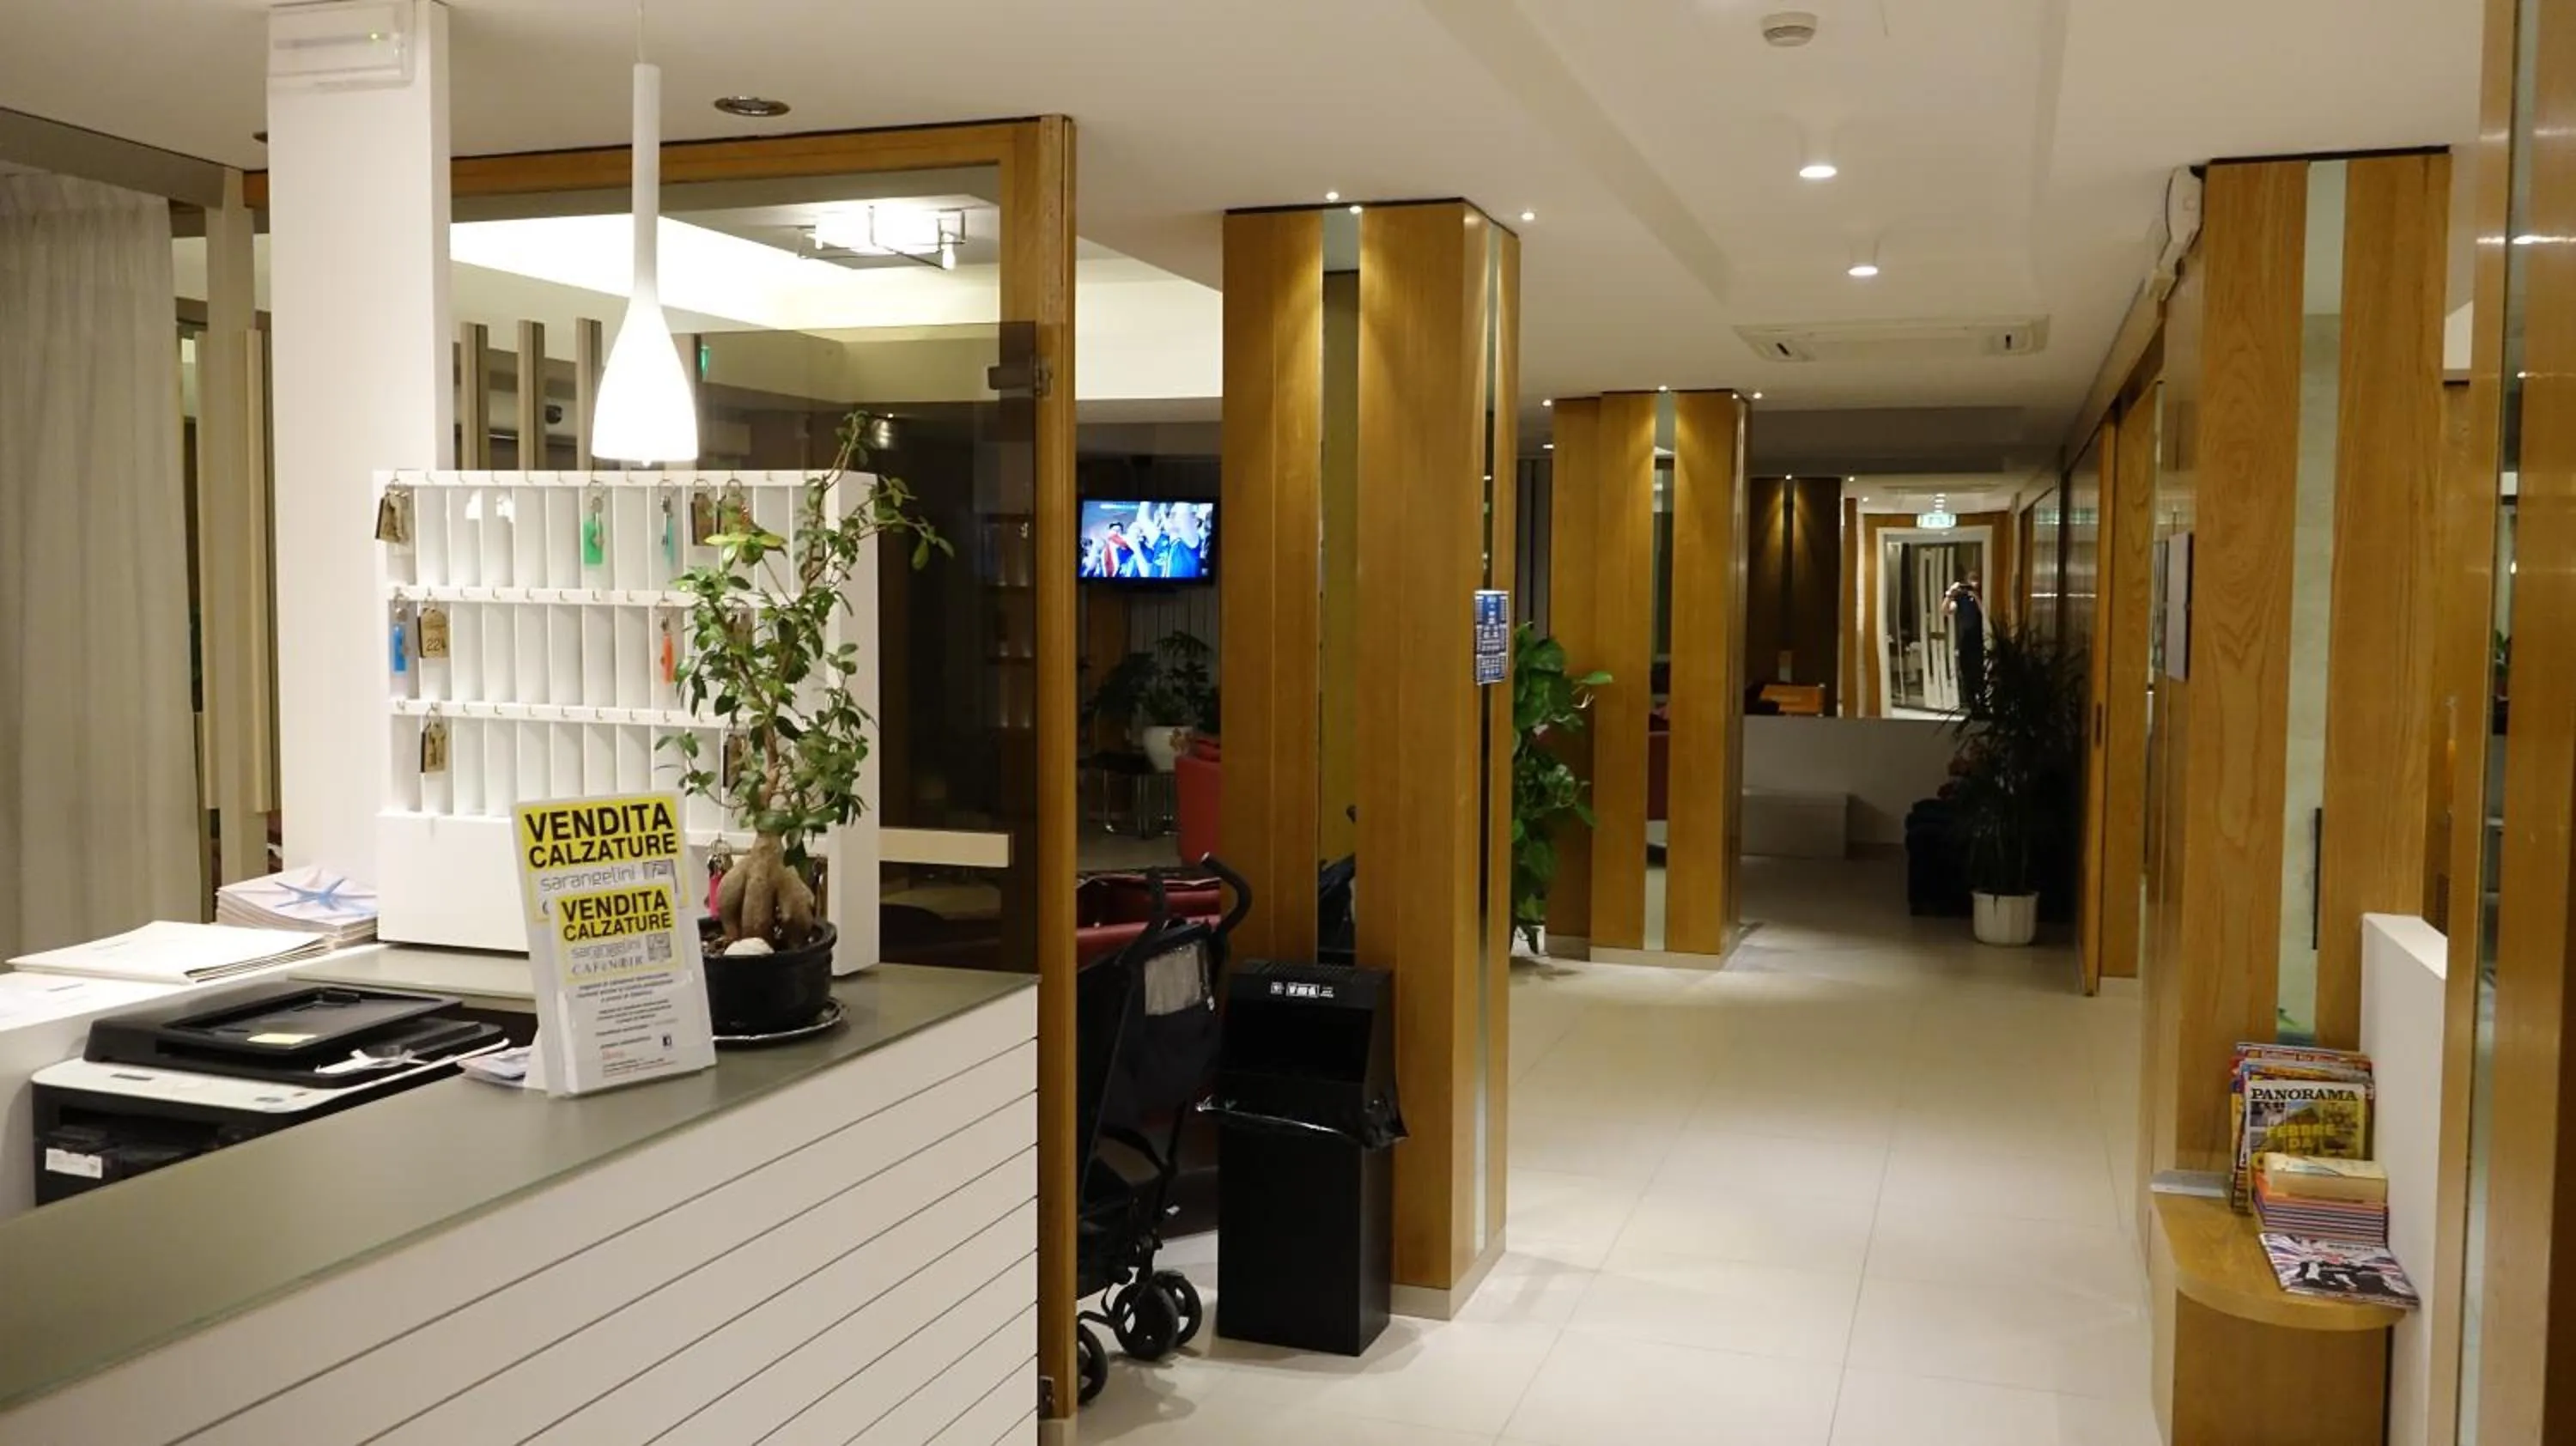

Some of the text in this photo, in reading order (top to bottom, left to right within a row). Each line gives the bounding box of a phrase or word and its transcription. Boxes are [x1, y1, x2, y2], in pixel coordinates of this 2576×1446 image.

[525, 802, 673, 842] VENDITA
[529, 832, 677, 869] CALZATURE
[540, 866, 635, 892] sarangelini
[561, 889, 669, 922] VENDITA
[563, 912, 672, 941] CALZATURE
[2251, 1087, 2359, 1102] PANORAMA
